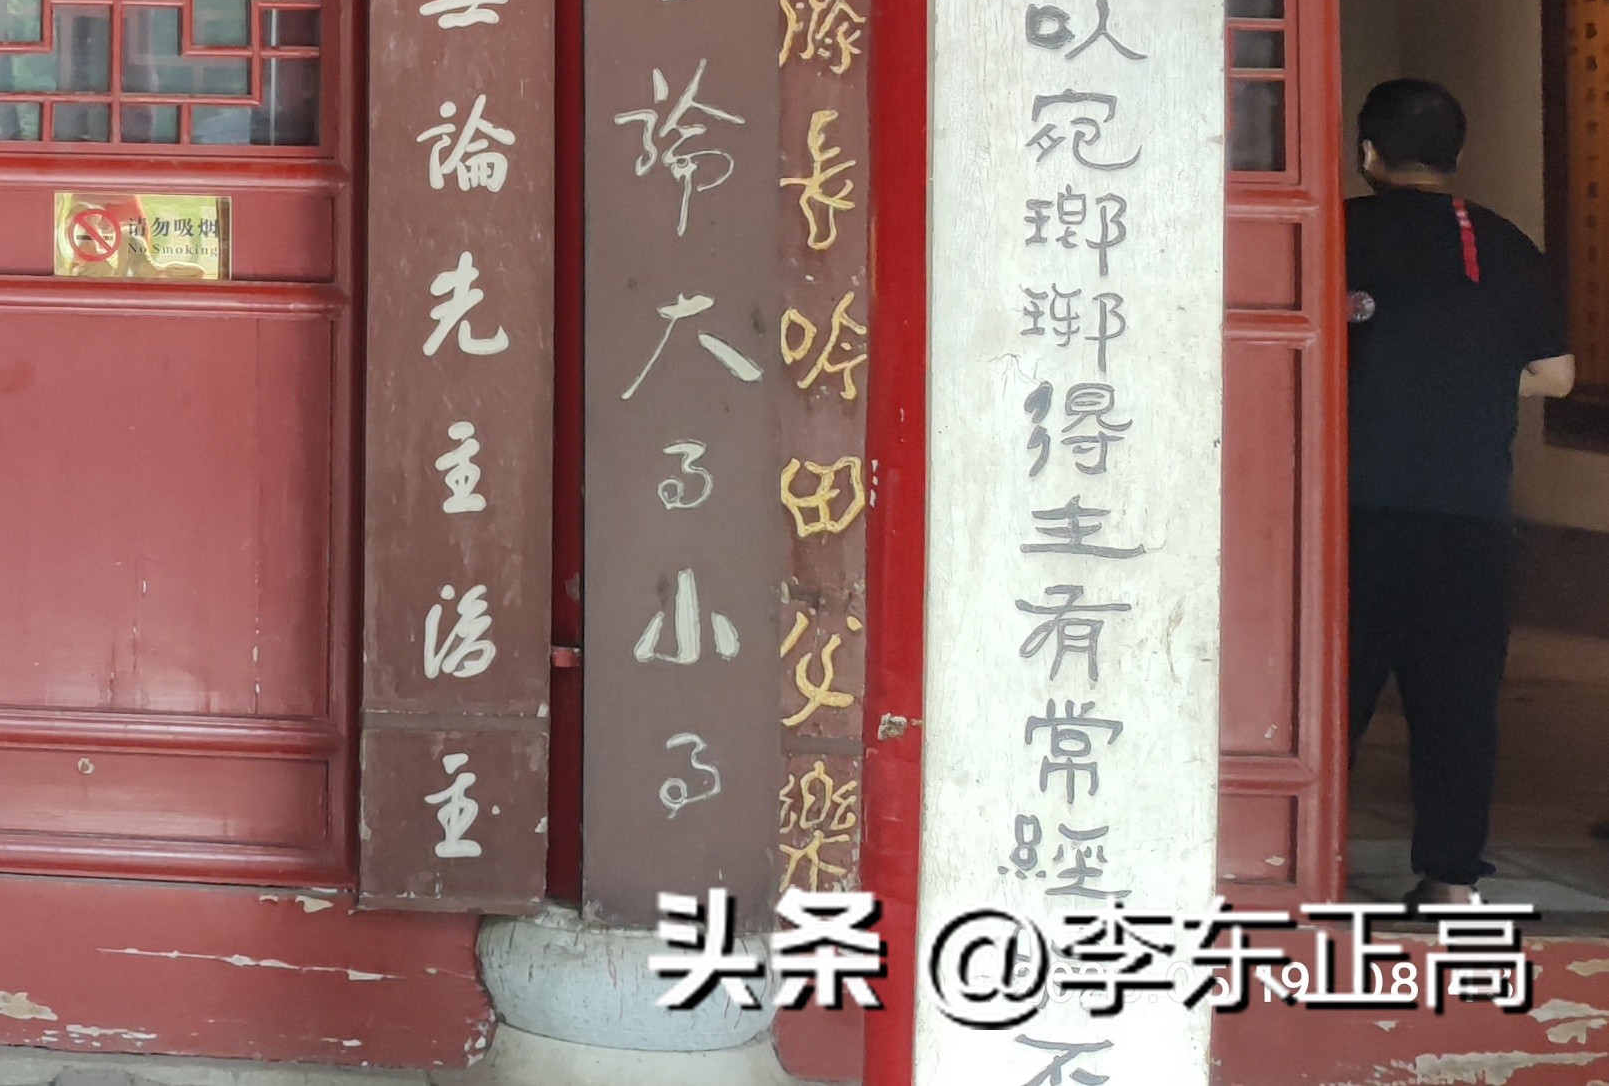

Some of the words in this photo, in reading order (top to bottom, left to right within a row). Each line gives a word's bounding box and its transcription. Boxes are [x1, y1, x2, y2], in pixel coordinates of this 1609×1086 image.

[128, 217, 219, 238] 请勿吸烟
[152, 242, 218, 258] Smoking
